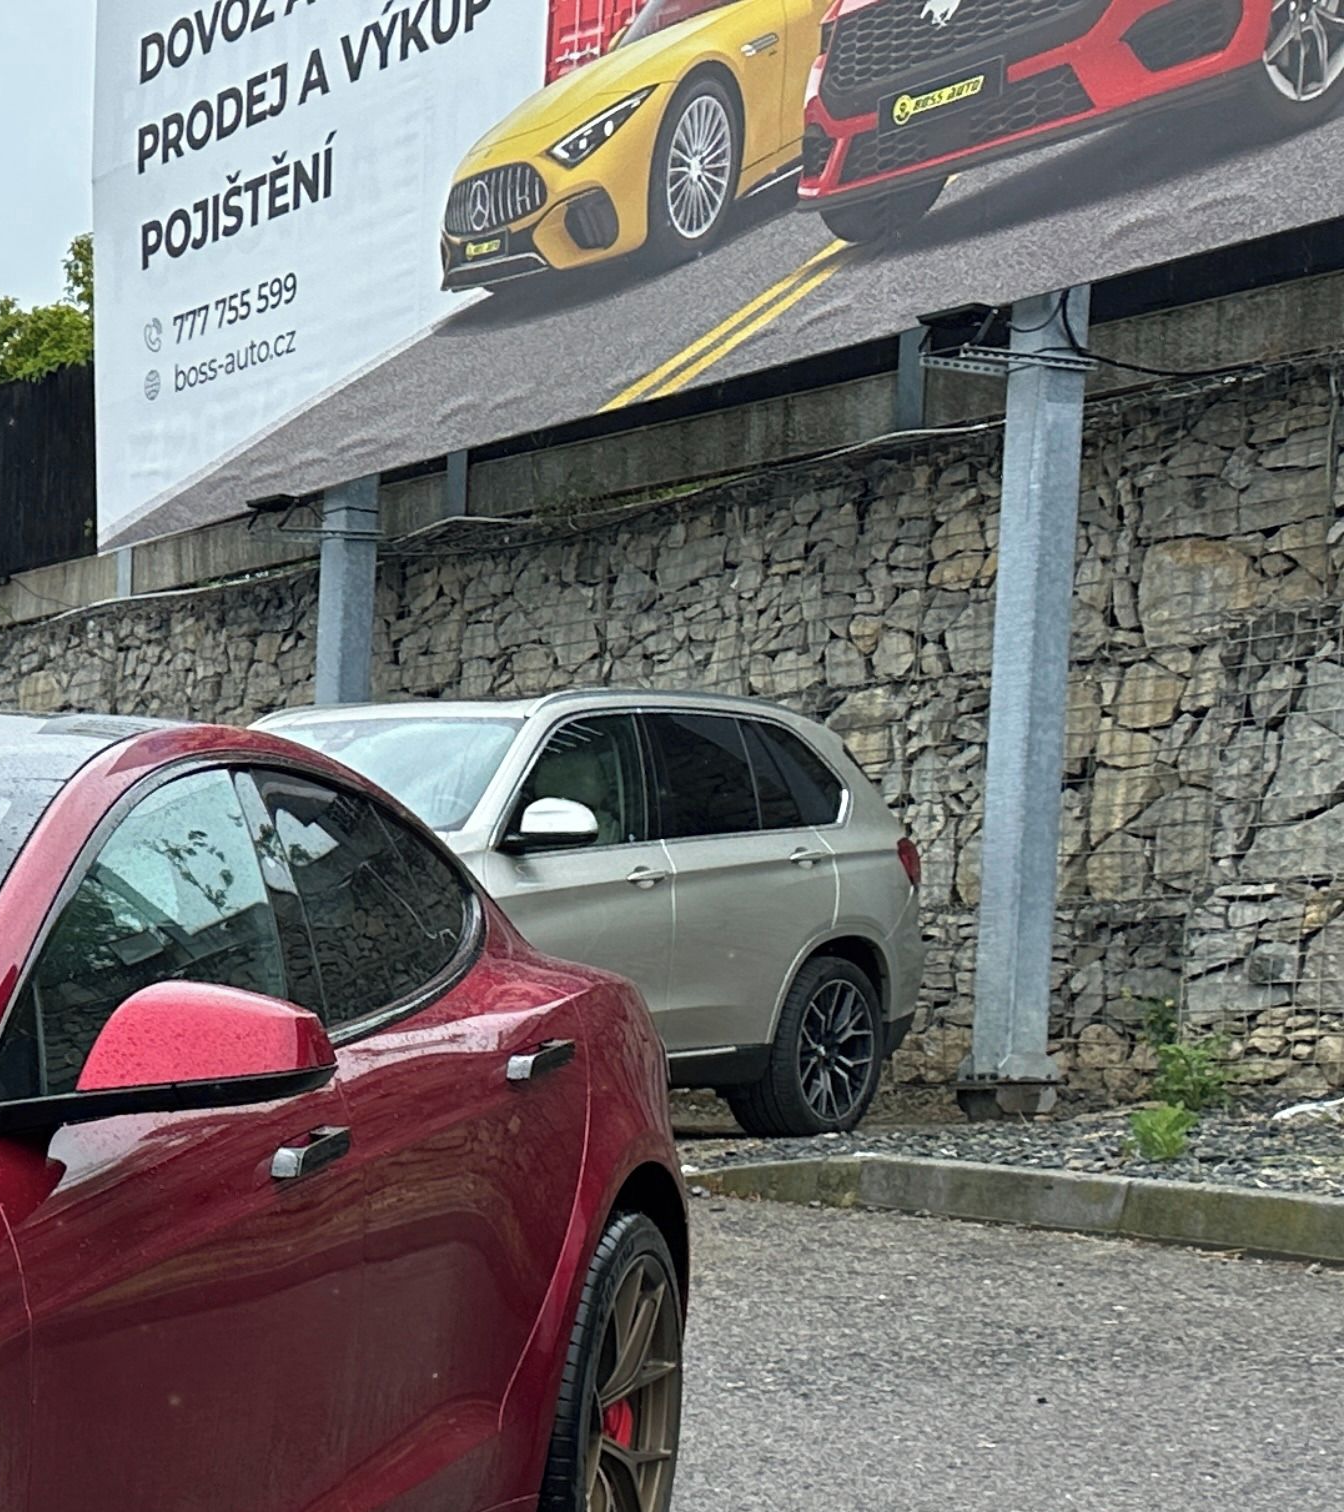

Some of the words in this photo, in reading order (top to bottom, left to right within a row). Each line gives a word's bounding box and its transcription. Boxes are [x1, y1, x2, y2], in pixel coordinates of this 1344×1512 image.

[139, 0, 276, 85] DOVOZ
[137, 61, 289, 175] PRODEJ
[297, 47, 331, 106] A
[339, 0, 492, 84] VÝKUP
[141, 129, 338, 271] POJIŠTĚNÍ
[172, 303, 210, 345] 777
[214, 287, 252, 330] 755
[255, 271, 298, 314] 599
[174, 329, 297, 393] boss-auto.cz
